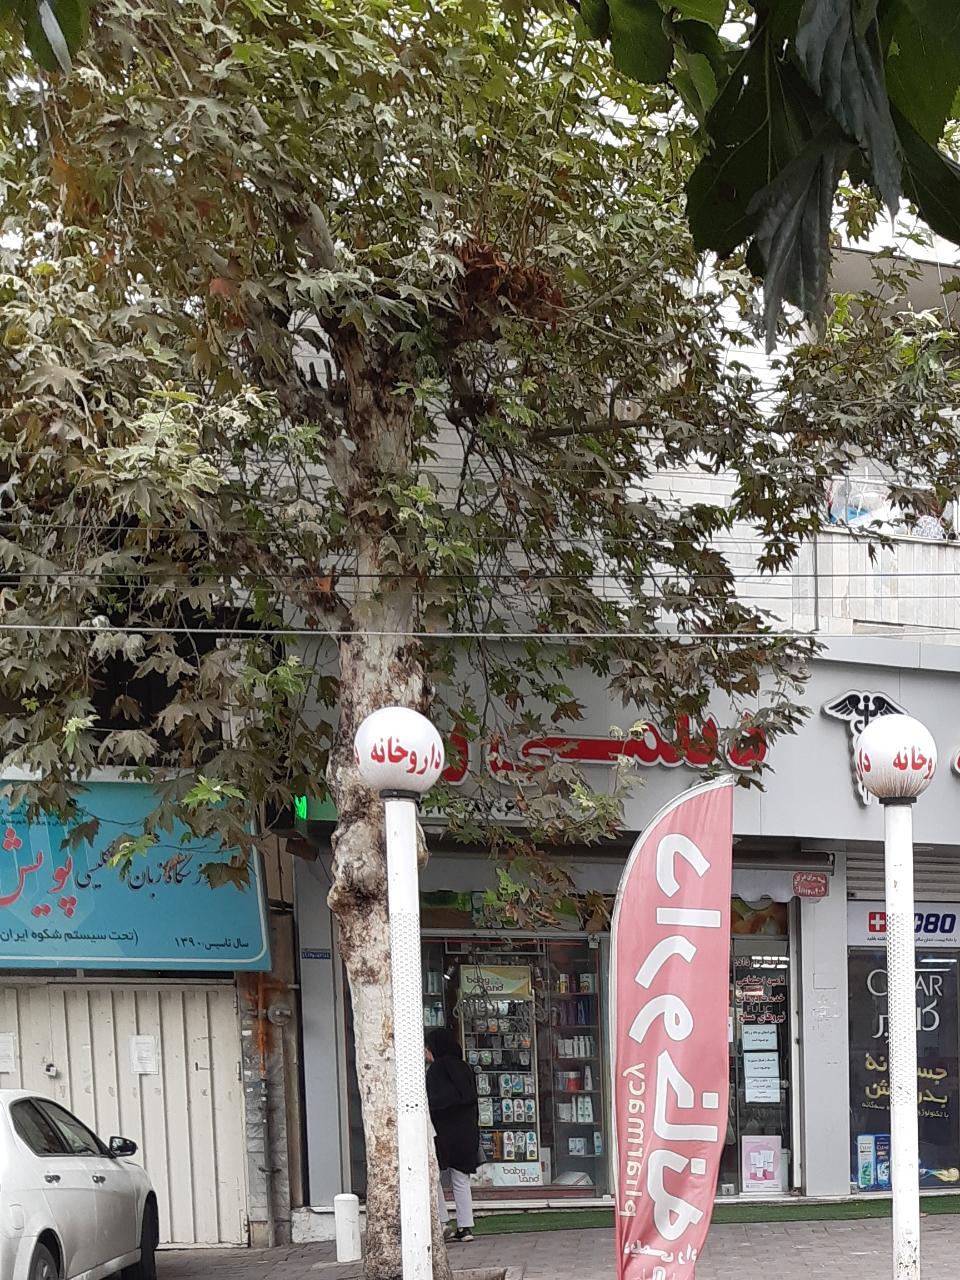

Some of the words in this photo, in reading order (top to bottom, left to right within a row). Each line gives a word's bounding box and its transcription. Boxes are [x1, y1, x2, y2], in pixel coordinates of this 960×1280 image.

[370, 736, 442, 775] داروخانه
[0, 928, 28, 942] ایران
[31, 928, 62, 941] شکوه
[64, 931, 107, 942] سیستم
[175, 937, 201, 948] ۱۳۹۰
[233, 938, 249, 949] سال
[866, 969, 943, 997] CAR
[502, 1166, 526, 1176] baby
[518, 1174, 540, 1183] land
